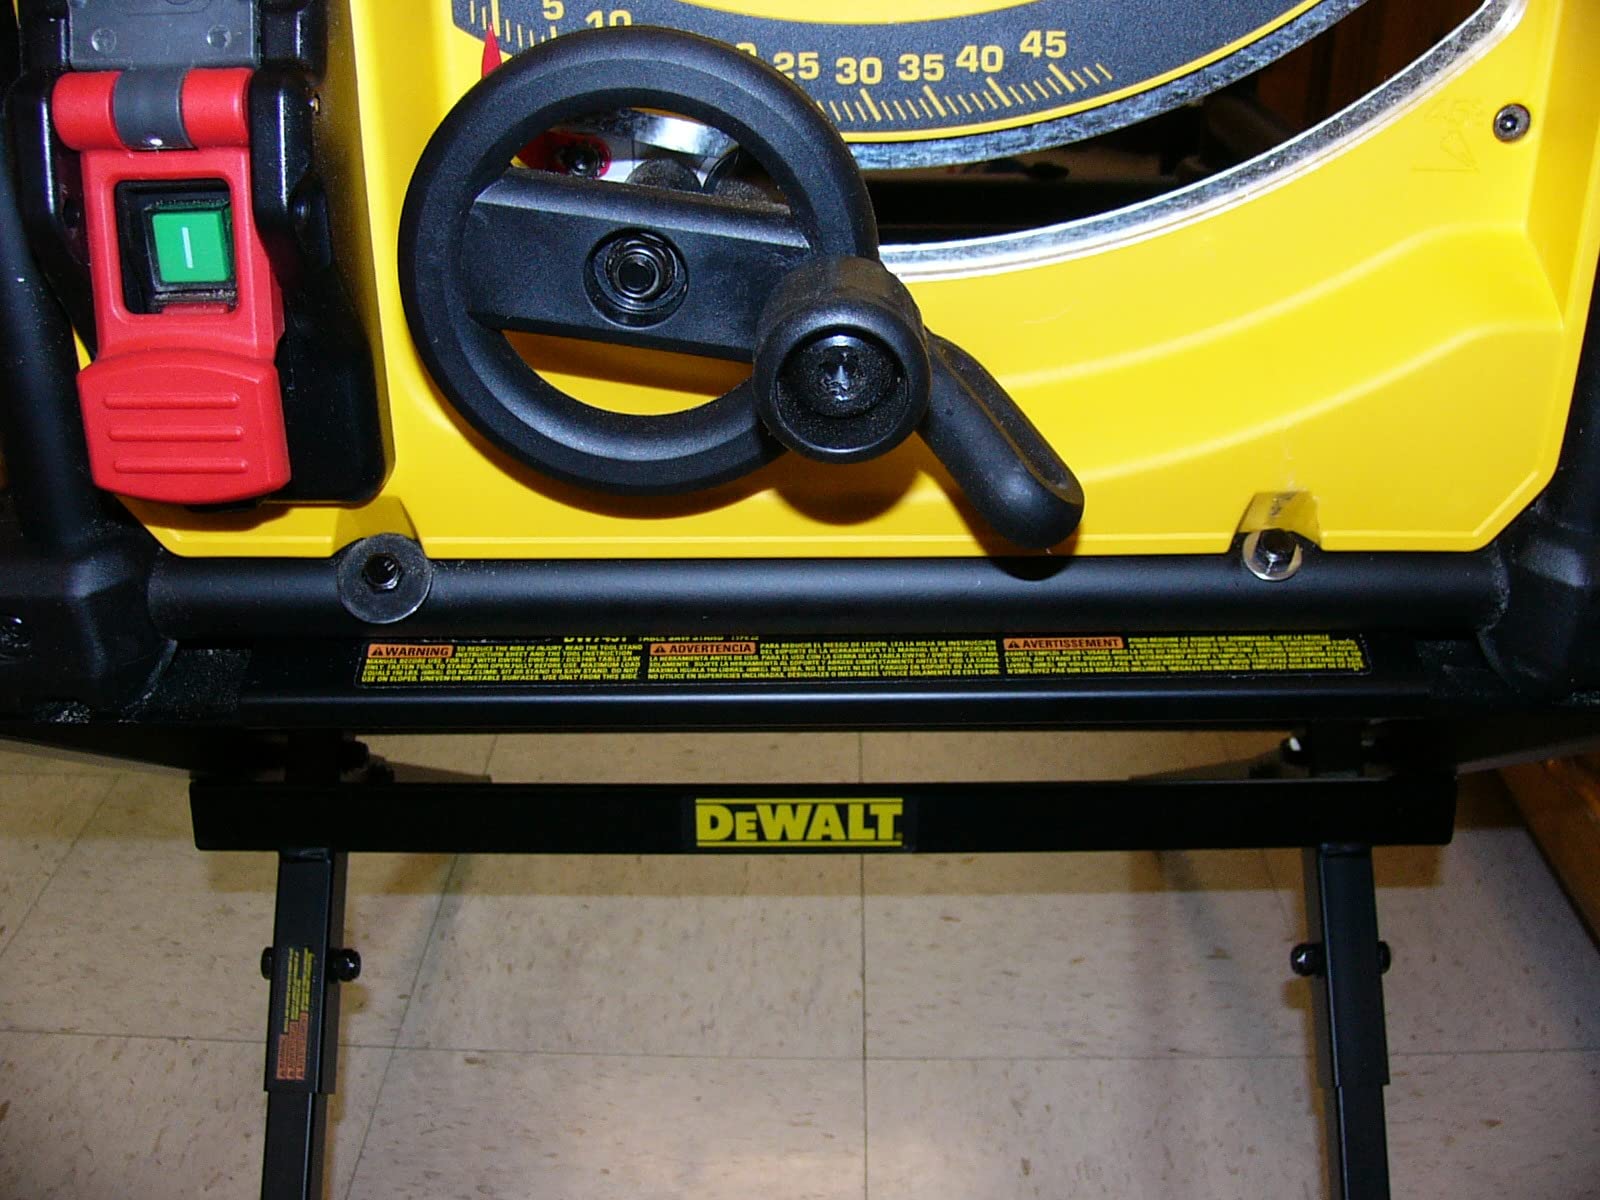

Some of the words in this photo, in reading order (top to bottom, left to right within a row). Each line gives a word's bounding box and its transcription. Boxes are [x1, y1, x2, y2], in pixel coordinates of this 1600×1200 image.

[1020, 30, 1067, 59] 45
[774, 52, 819, 80] 25
[835, 57, 882, 85] 30
[898, 54, 945, 82] 35
[955, 45, 1003, 73] 40
[385, 647, 450, 656] WARNING
[669, 644, 752, 653] ADVERTENCIA
[1023, 638, 1118, 649] AVERTISSEMENT
[695, 803, 903, 841] DEWALT
